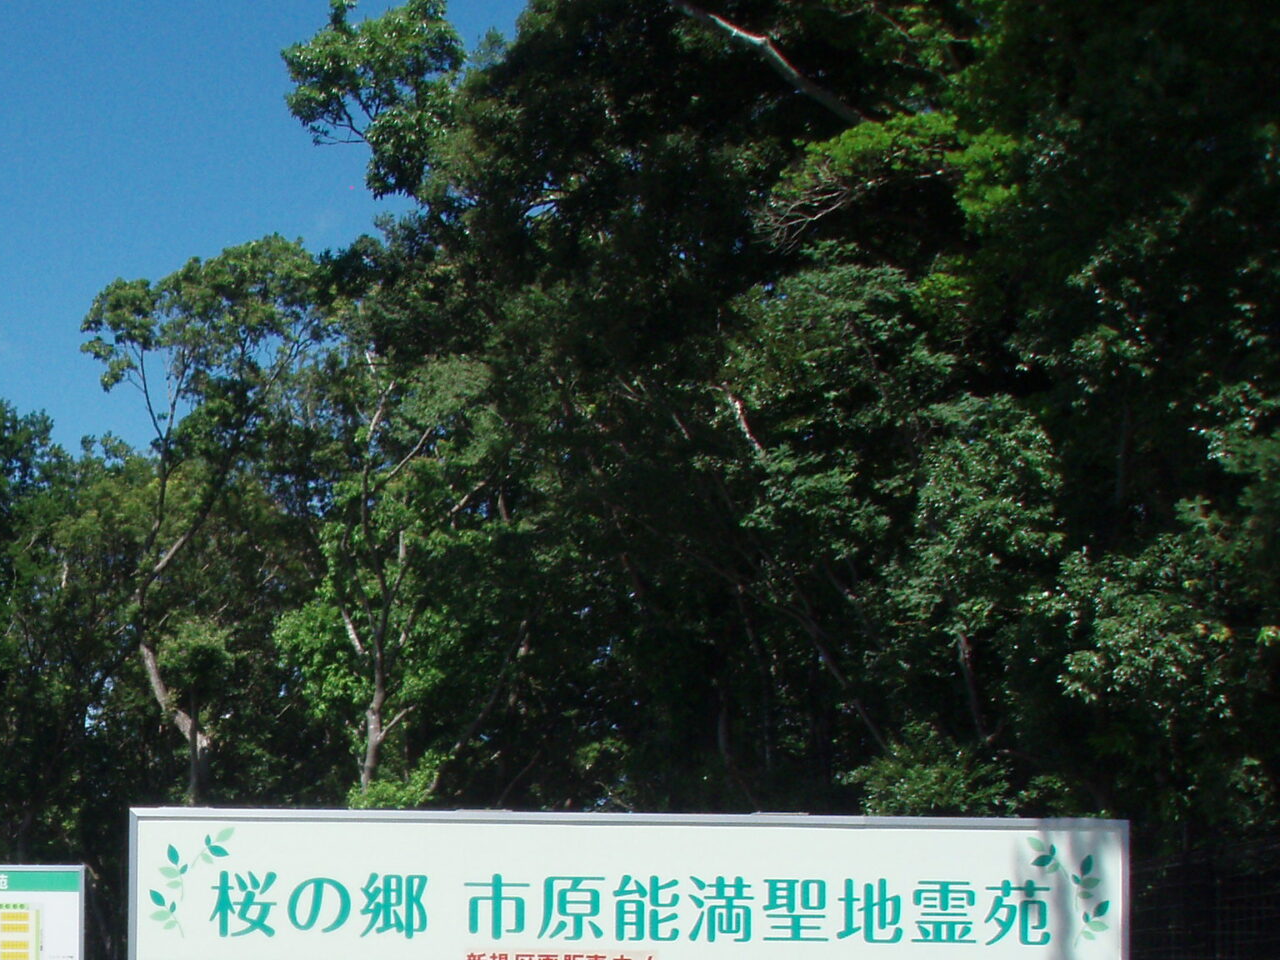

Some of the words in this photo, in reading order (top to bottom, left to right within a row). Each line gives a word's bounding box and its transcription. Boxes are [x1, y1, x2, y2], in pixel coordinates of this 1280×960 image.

[209, 870, 428, 940] 桜の郷
[464, 873, 1052, 946] 市原能満聖地霊苑
